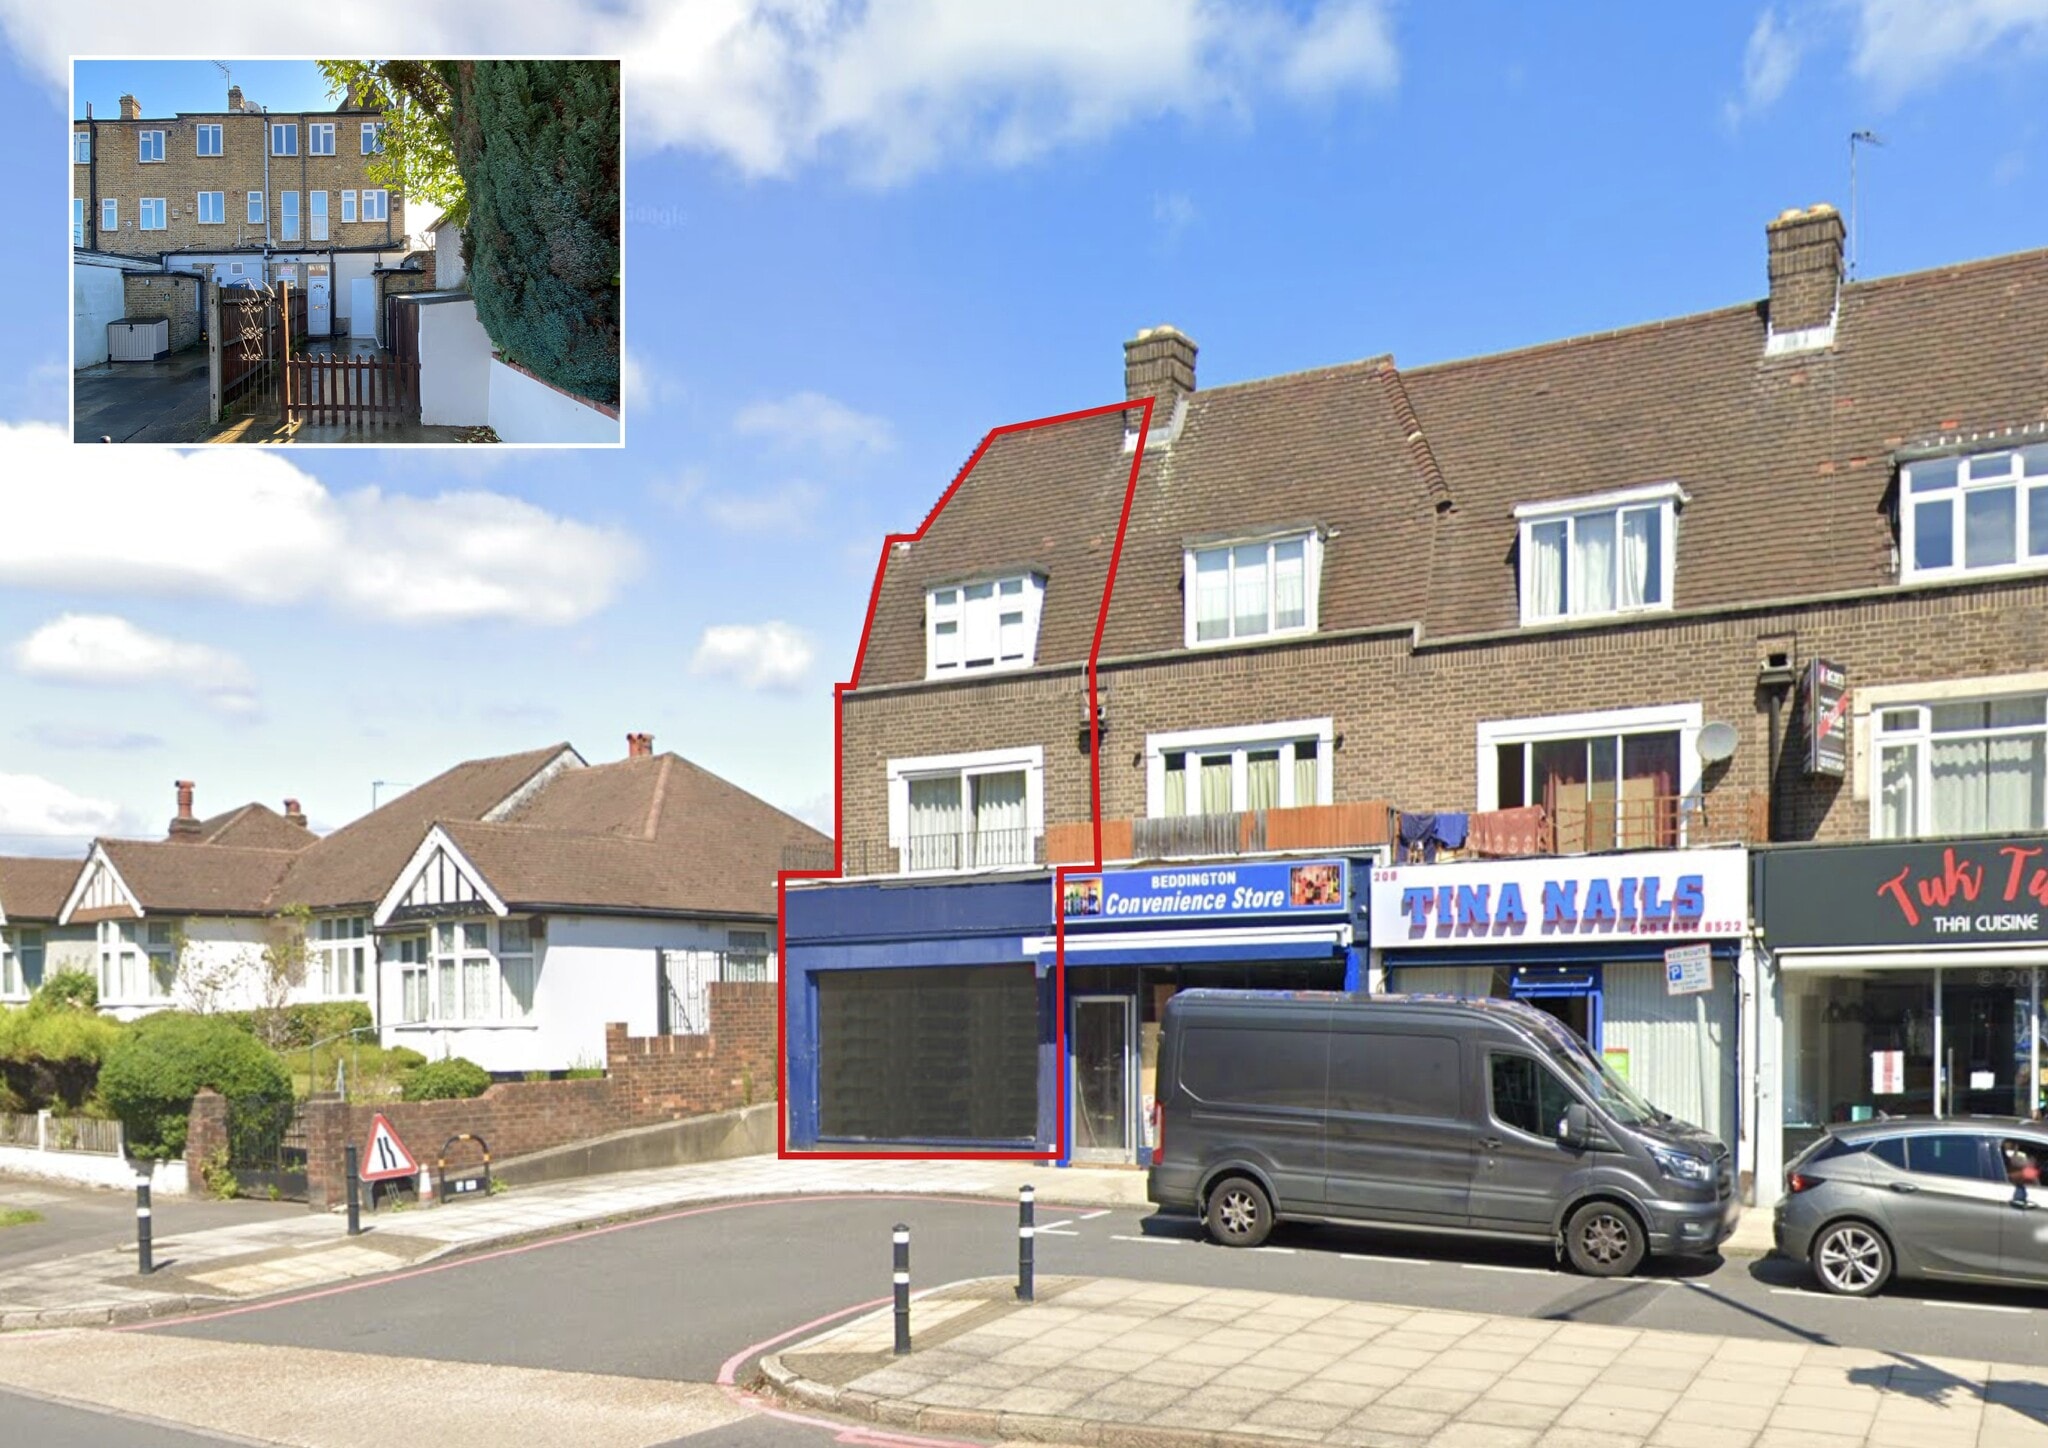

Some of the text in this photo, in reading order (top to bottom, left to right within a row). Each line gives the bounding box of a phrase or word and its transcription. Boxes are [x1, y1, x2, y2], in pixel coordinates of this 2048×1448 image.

[1151, 871, 1236, 890] BEDDINGTON
[1877, 847, 1983, 926] Tuk
[1105, 886, 1285, 915] Convenience Store
[1401, 874, 1705, 936] TINA NAILS
[1933, 913, 2039, 933] THAI CUISINE
